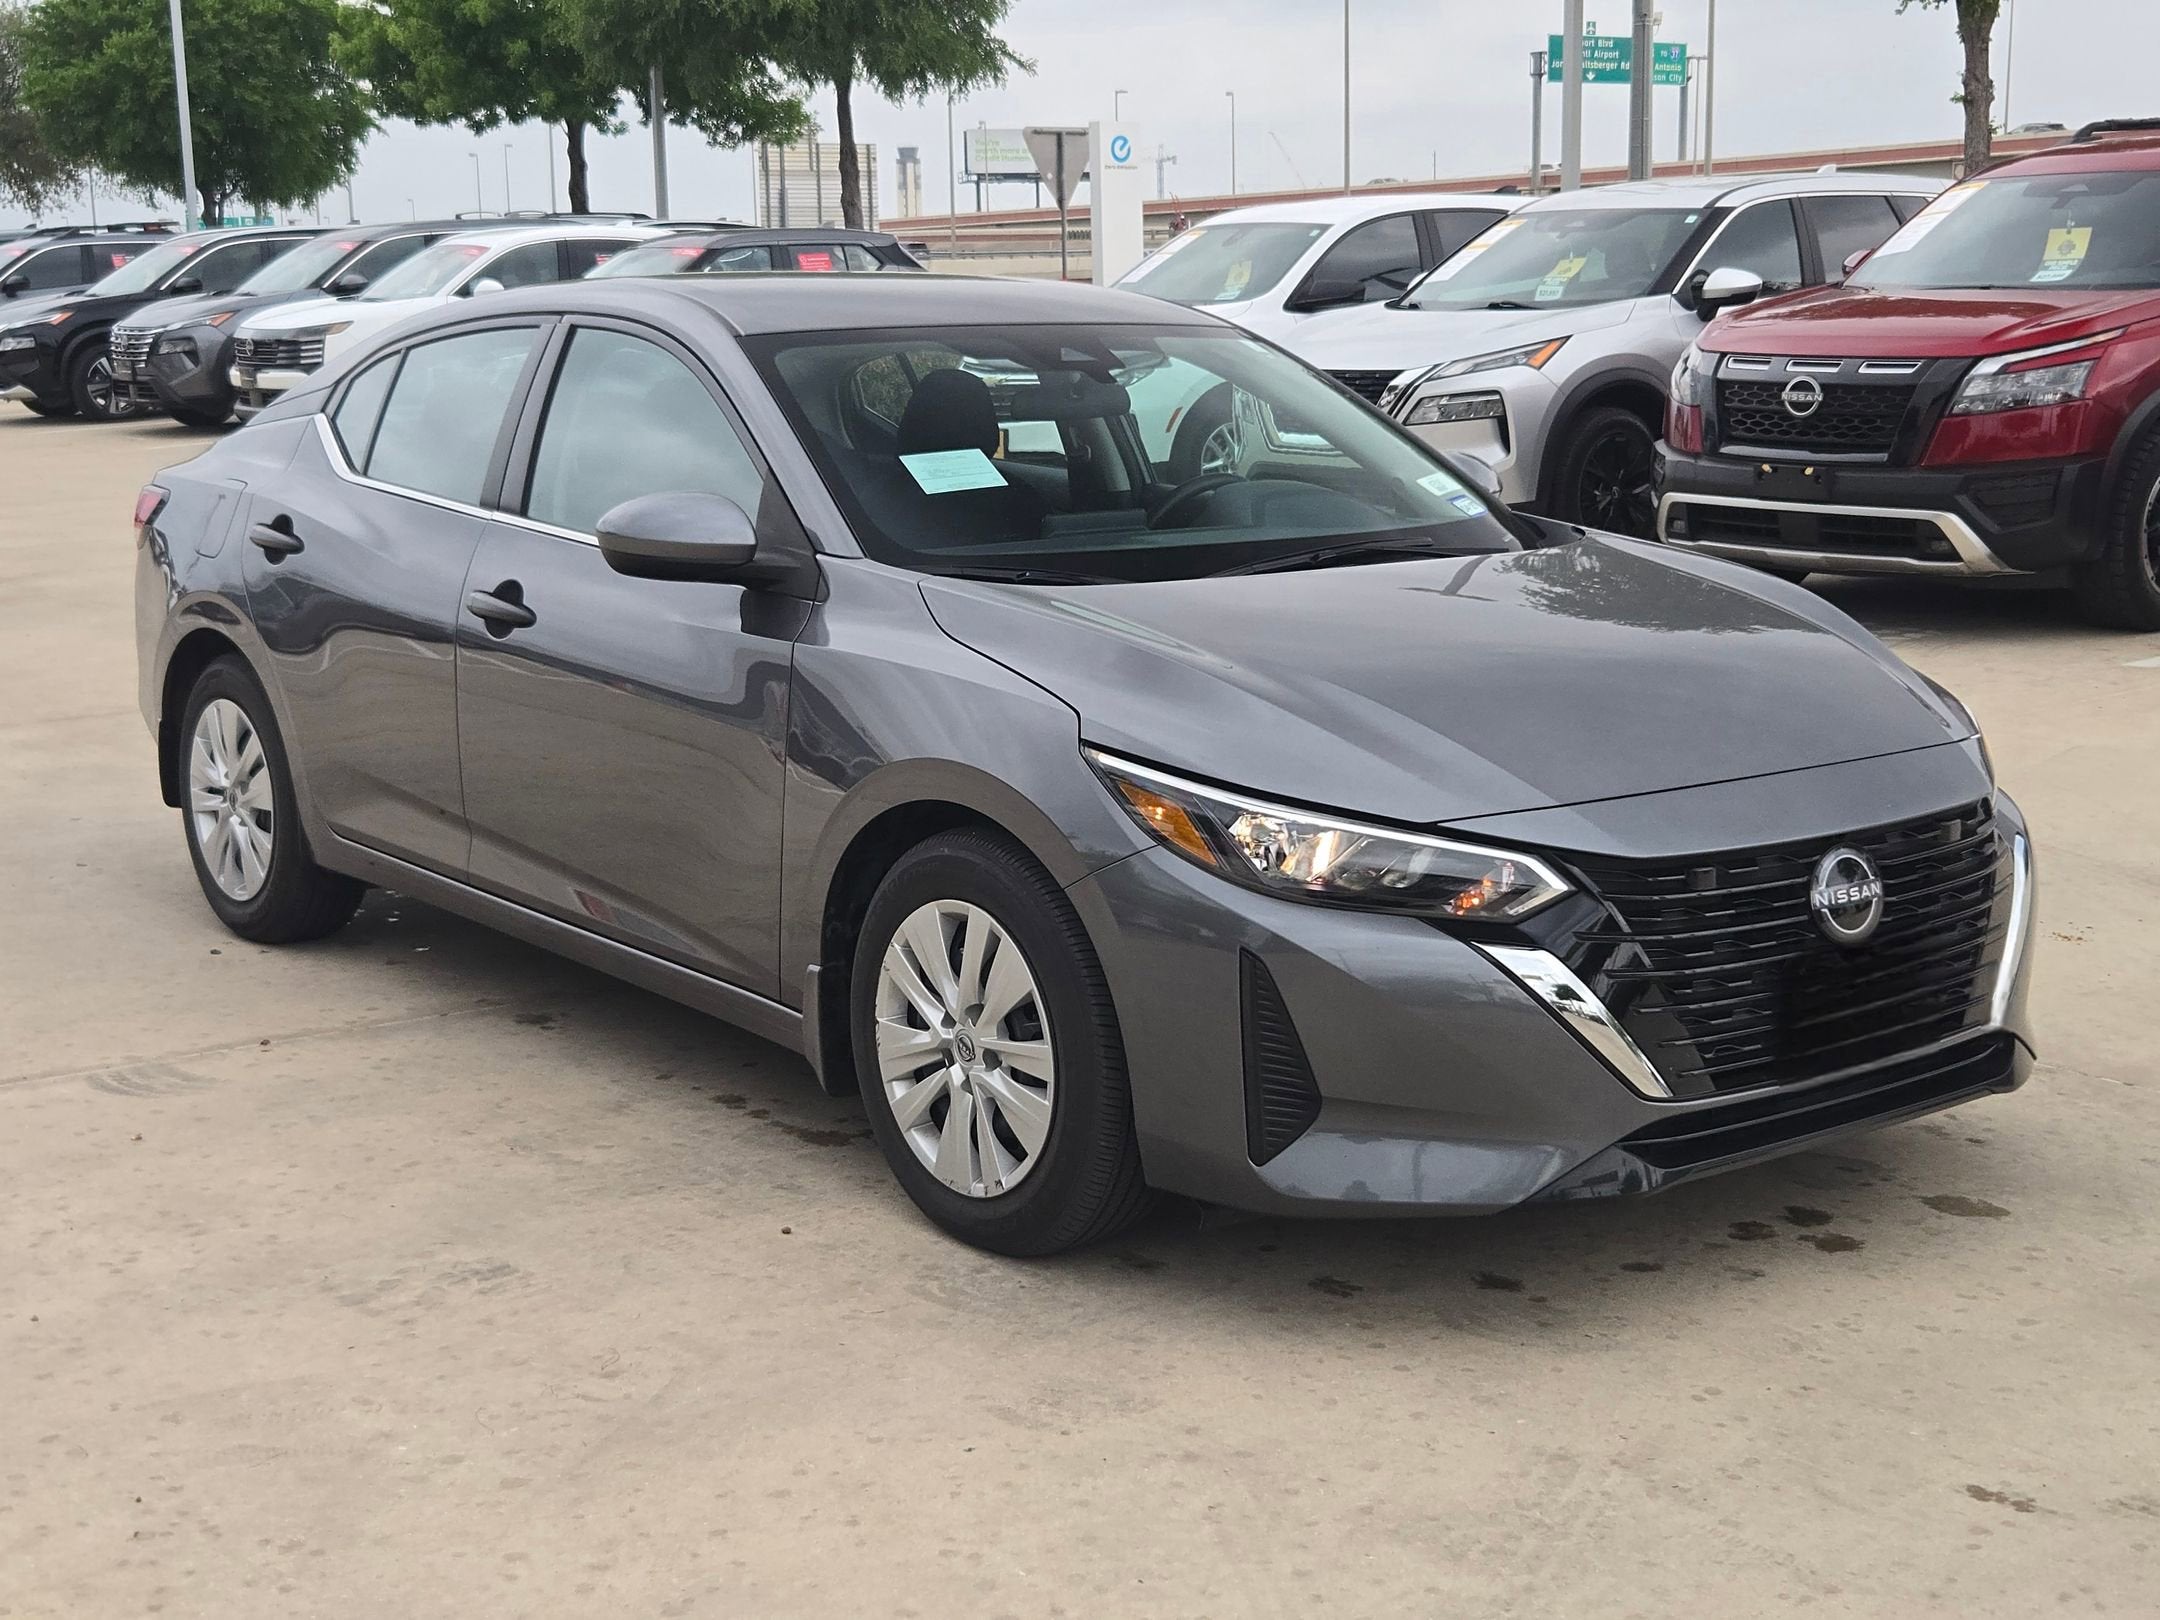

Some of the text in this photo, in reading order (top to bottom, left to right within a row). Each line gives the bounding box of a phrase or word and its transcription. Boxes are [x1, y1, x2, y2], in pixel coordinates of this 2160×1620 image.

[1594, 50, 1619, 60] Airport
[1655, 63, 1682, 71] Antonio
[1669, 74, 1682, 82] City
[1781, 392, 1824, 402] NISSAN
[1814, 881, 1881, 907] NISSAN
